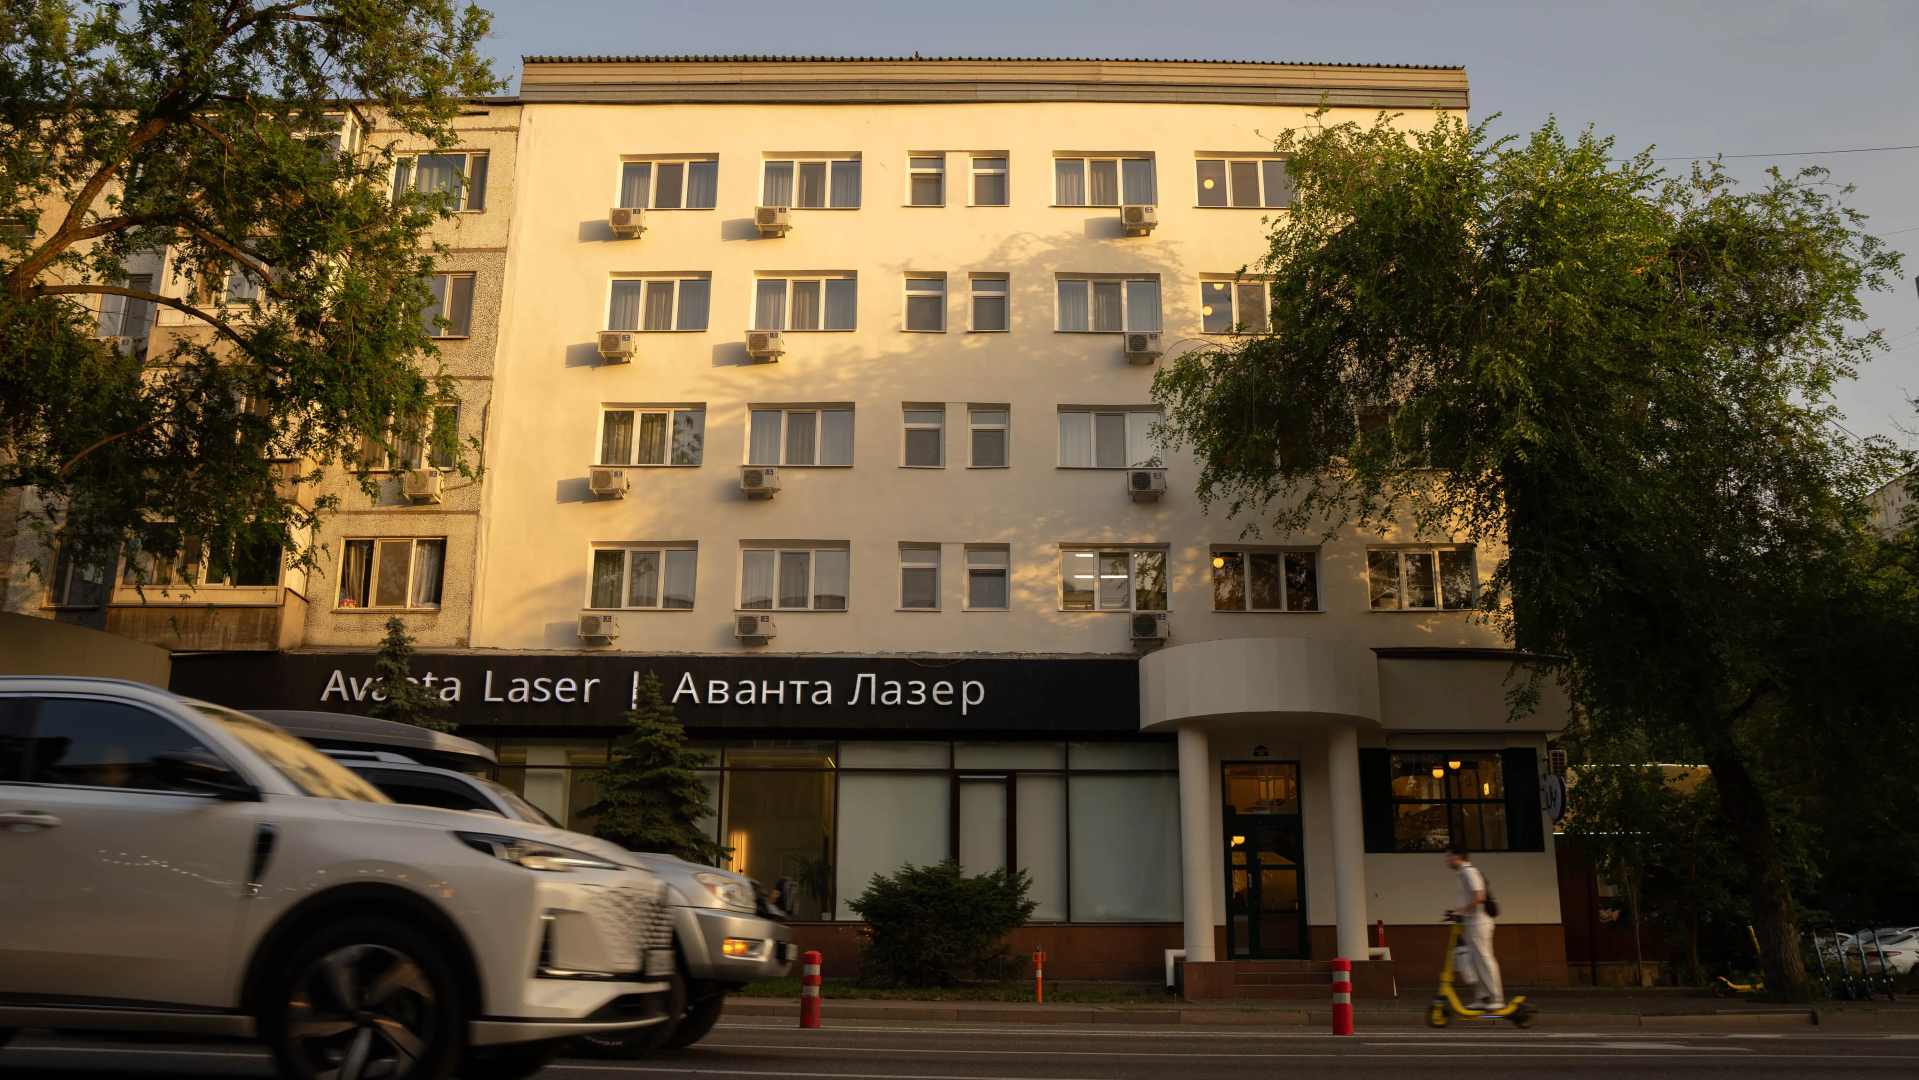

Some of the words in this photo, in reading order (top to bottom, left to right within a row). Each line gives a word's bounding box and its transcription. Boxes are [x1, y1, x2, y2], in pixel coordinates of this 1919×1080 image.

[320, 669, 462, 702] Avata
[483, 670, 600, 703] Laser
[671, 671, 833, 706] Аванта
[847, 673, 986, 716] Лазер
